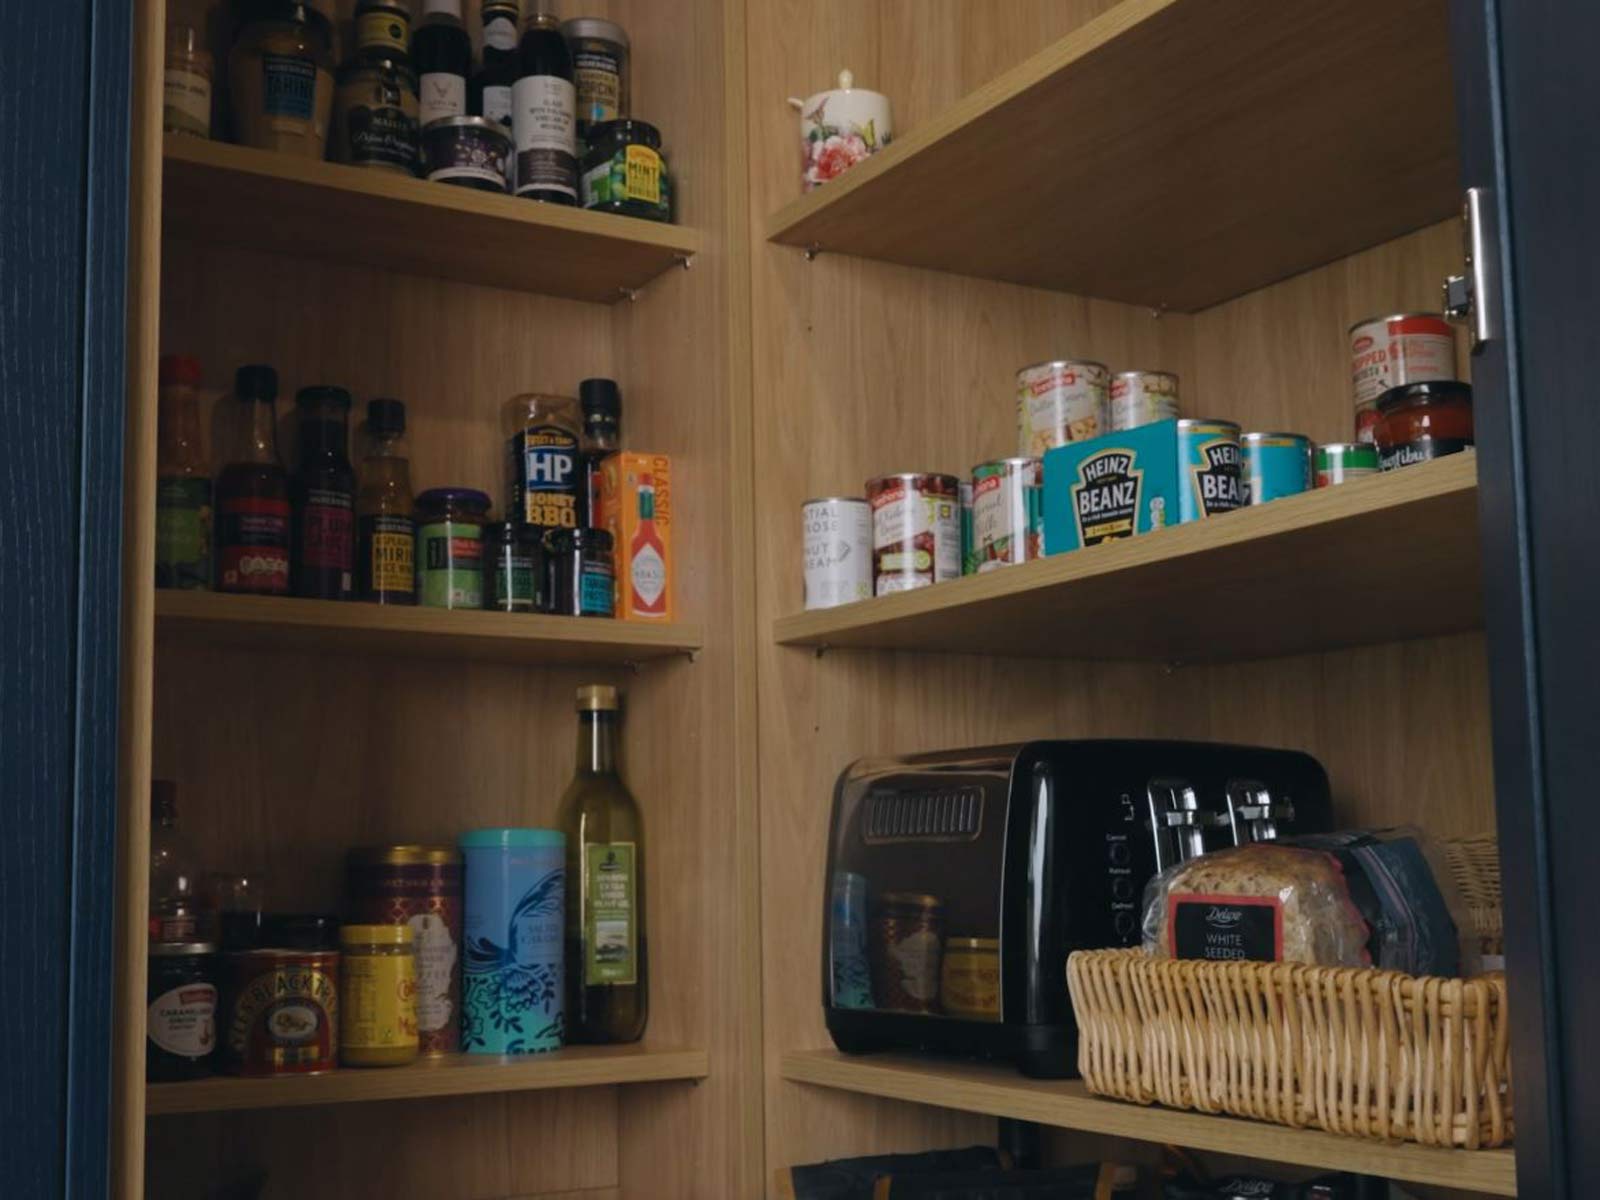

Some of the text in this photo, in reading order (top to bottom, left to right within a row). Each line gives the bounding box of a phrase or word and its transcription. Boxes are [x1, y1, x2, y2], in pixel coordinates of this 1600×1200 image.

[628, 161, 659, 183] MINT
[529, 451, 573, 484] HP
[1086, 455, 1129, 482] HEINZ
[652, 456, 669, 526] CLASSIC
[1079, 481, 1136, 516] BEANZ
[527, 506, 577, 529] BBQ
[1206, 933, 1243, 946] WHITE
[1204, 948, 1246, 960] SEEDED
